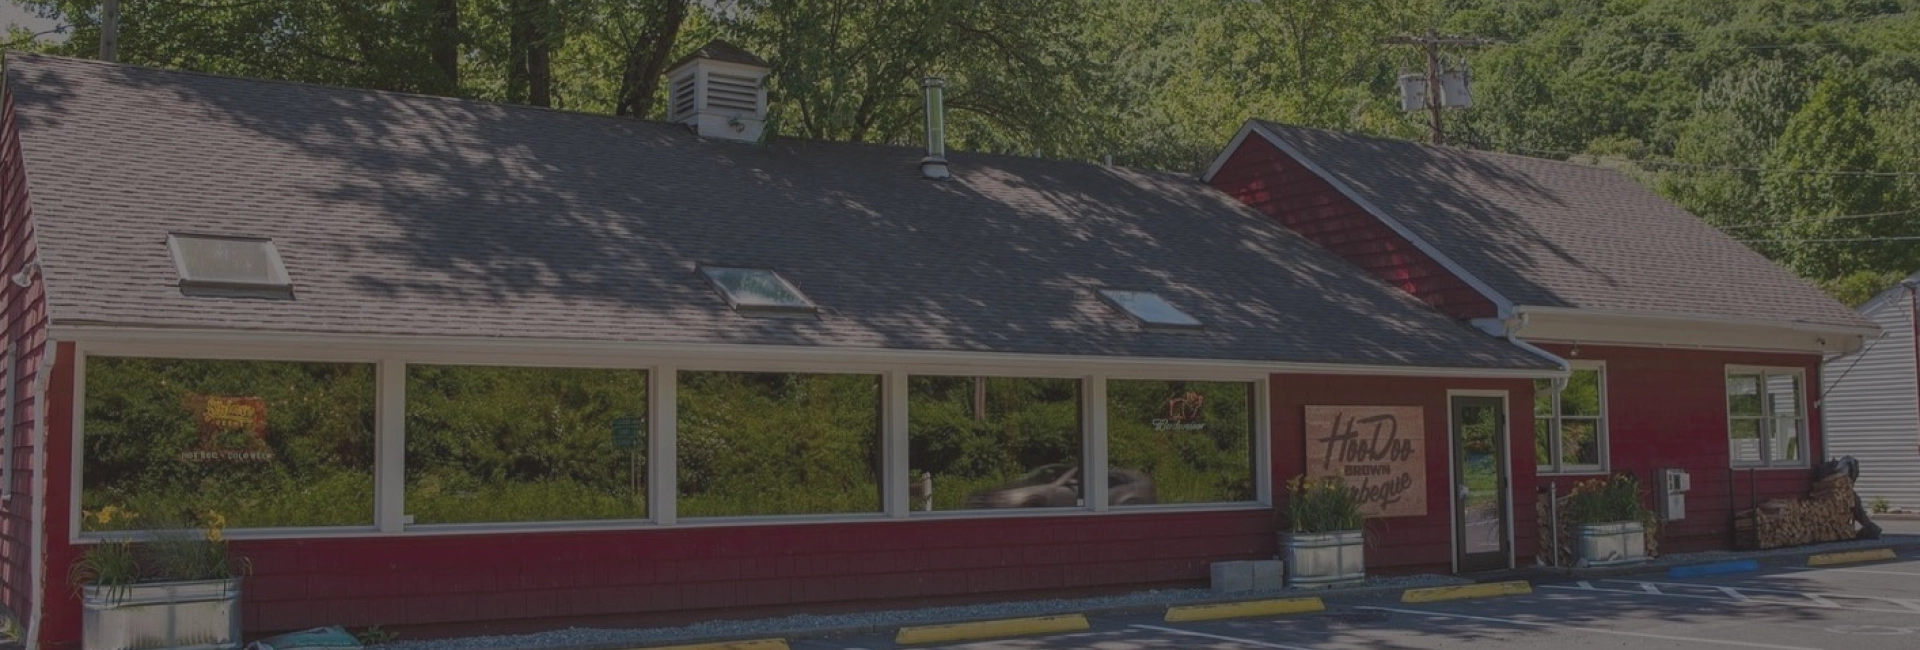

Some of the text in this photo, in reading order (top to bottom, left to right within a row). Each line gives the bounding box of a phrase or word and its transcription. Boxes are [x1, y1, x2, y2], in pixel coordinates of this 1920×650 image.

[1318, 412, 1415, 470] HooDoo
[1344, 465, 1391, 476] BROWN
[1322, 472, 1411, 510] rbeque
